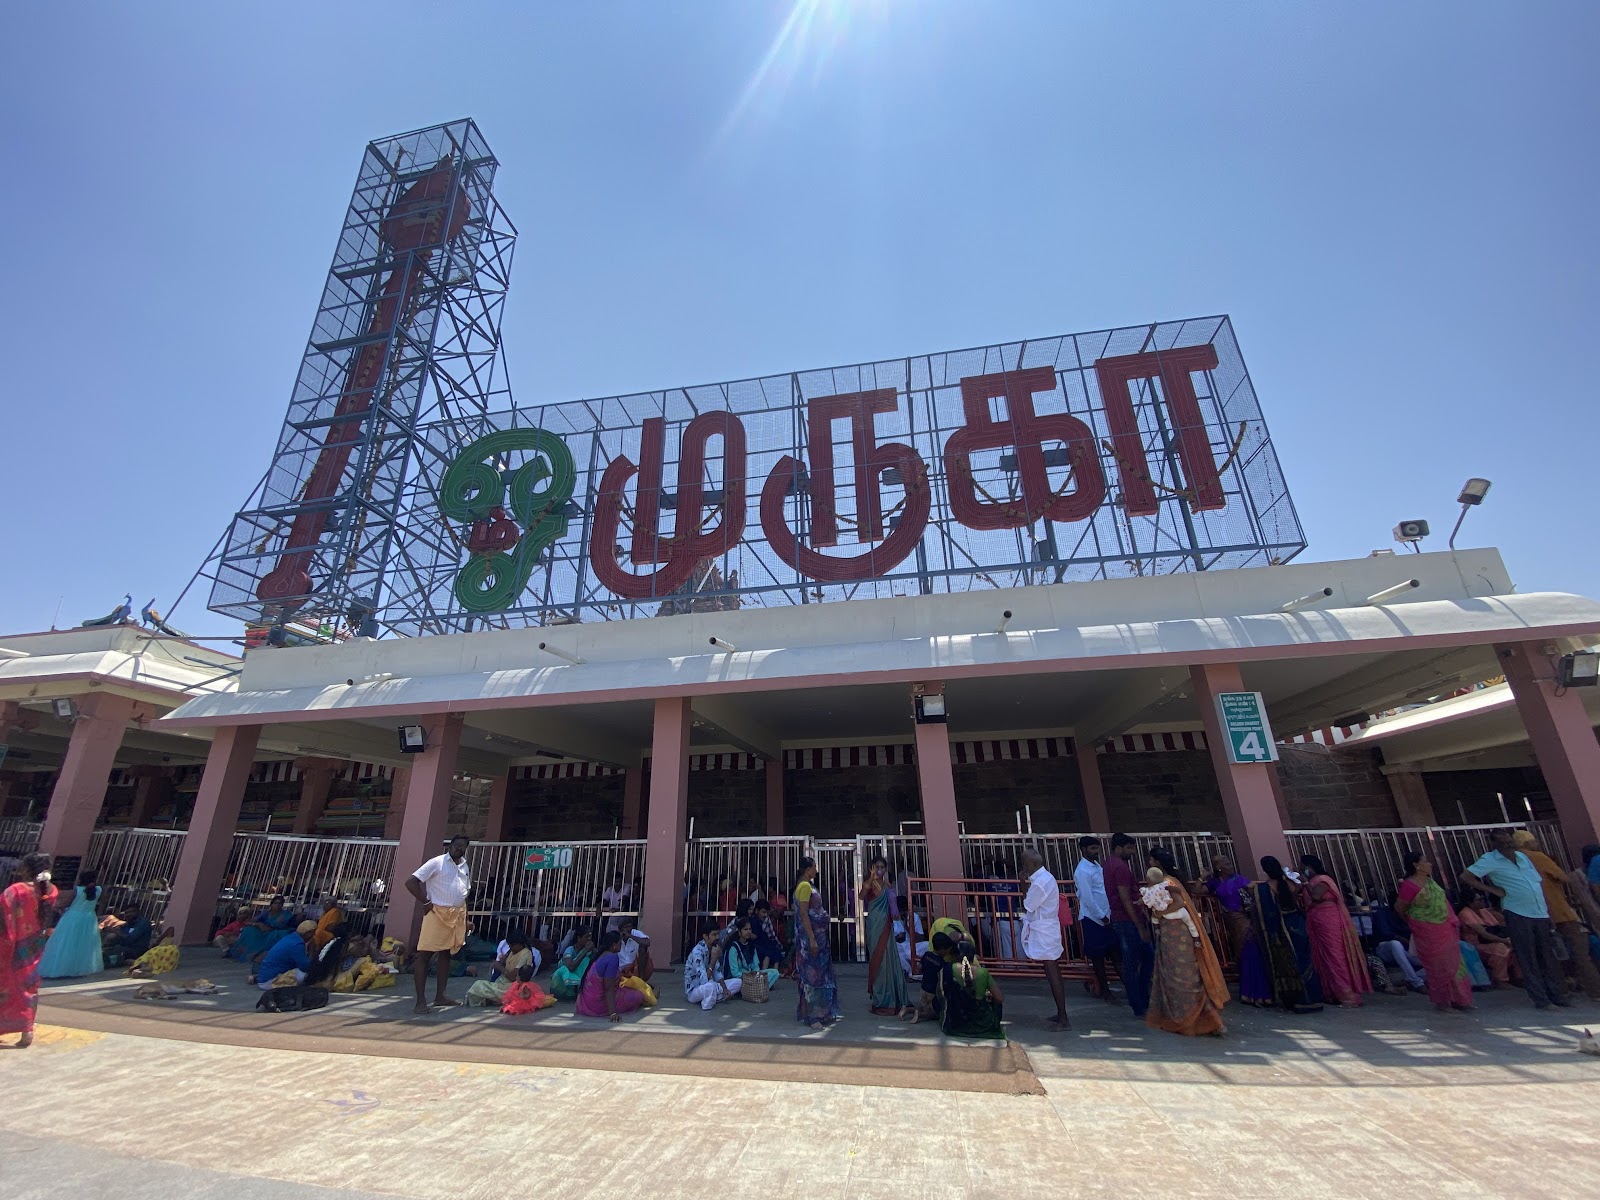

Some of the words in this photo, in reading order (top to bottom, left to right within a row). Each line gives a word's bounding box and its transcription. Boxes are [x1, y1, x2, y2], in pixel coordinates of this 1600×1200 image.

[590, 344, 1225, 599] முருகா
[1239, 732, 1265, 759] 4
[552, 848, 573, 867] 10
